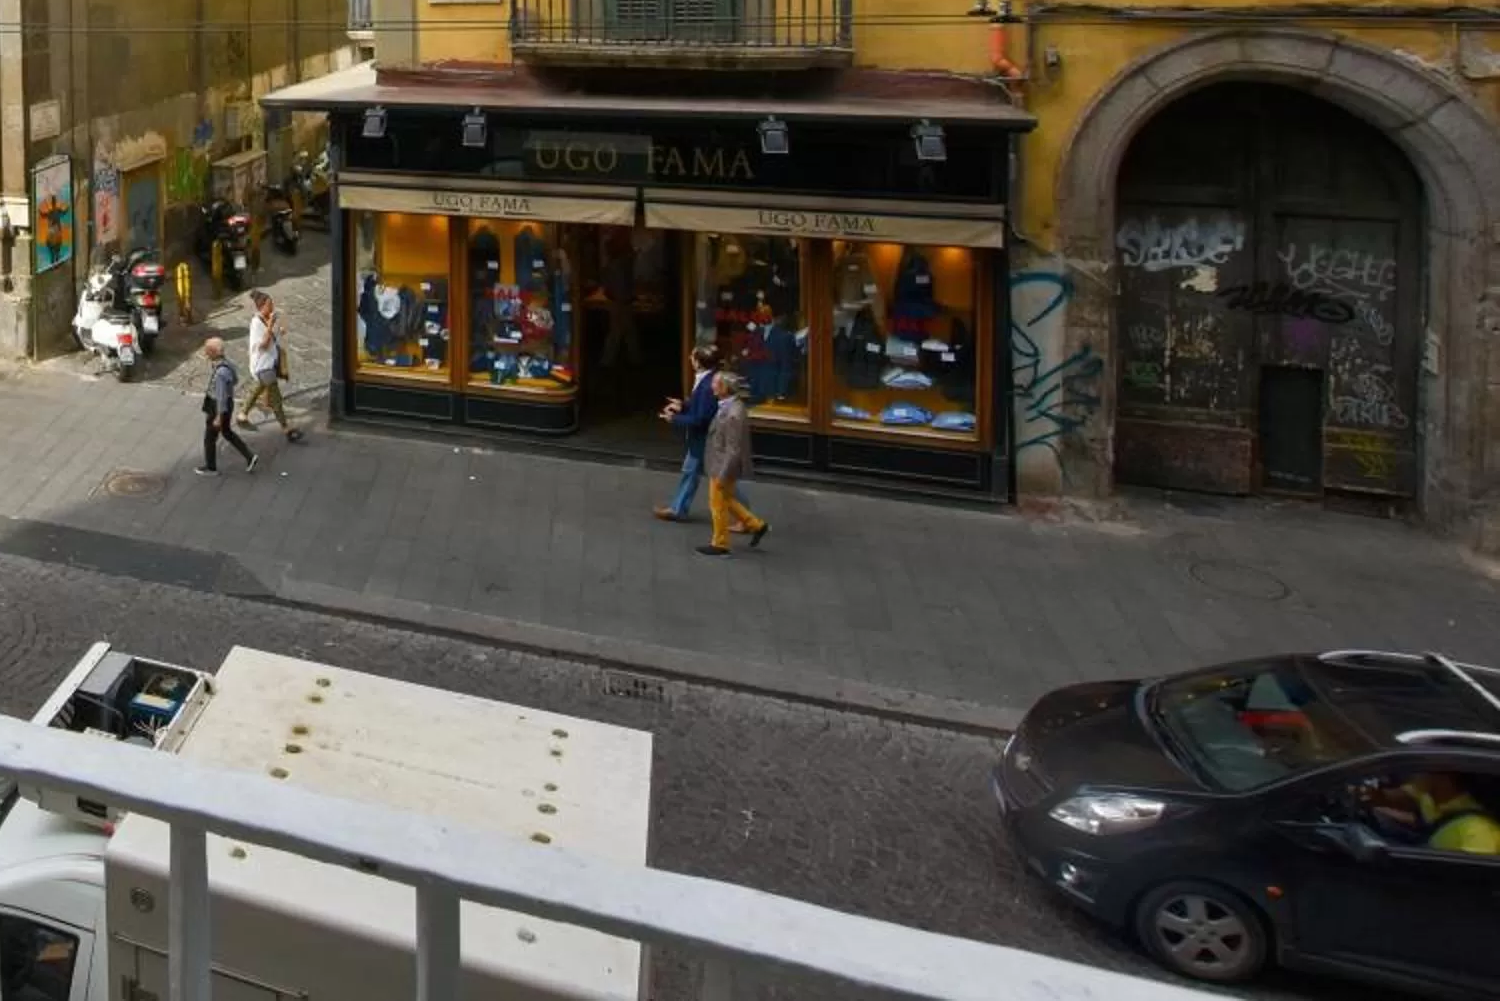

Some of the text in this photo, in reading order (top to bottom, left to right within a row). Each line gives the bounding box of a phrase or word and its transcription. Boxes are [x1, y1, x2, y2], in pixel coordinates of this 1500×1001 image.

[535, 139, 757, 179] UGO FAMA
[432, 190, 473, 208] UGO
[479, 195, 532, 212] FAMA
[757, 209, 808, 228] UGO
[813, 213, 876, 232] FAMA
